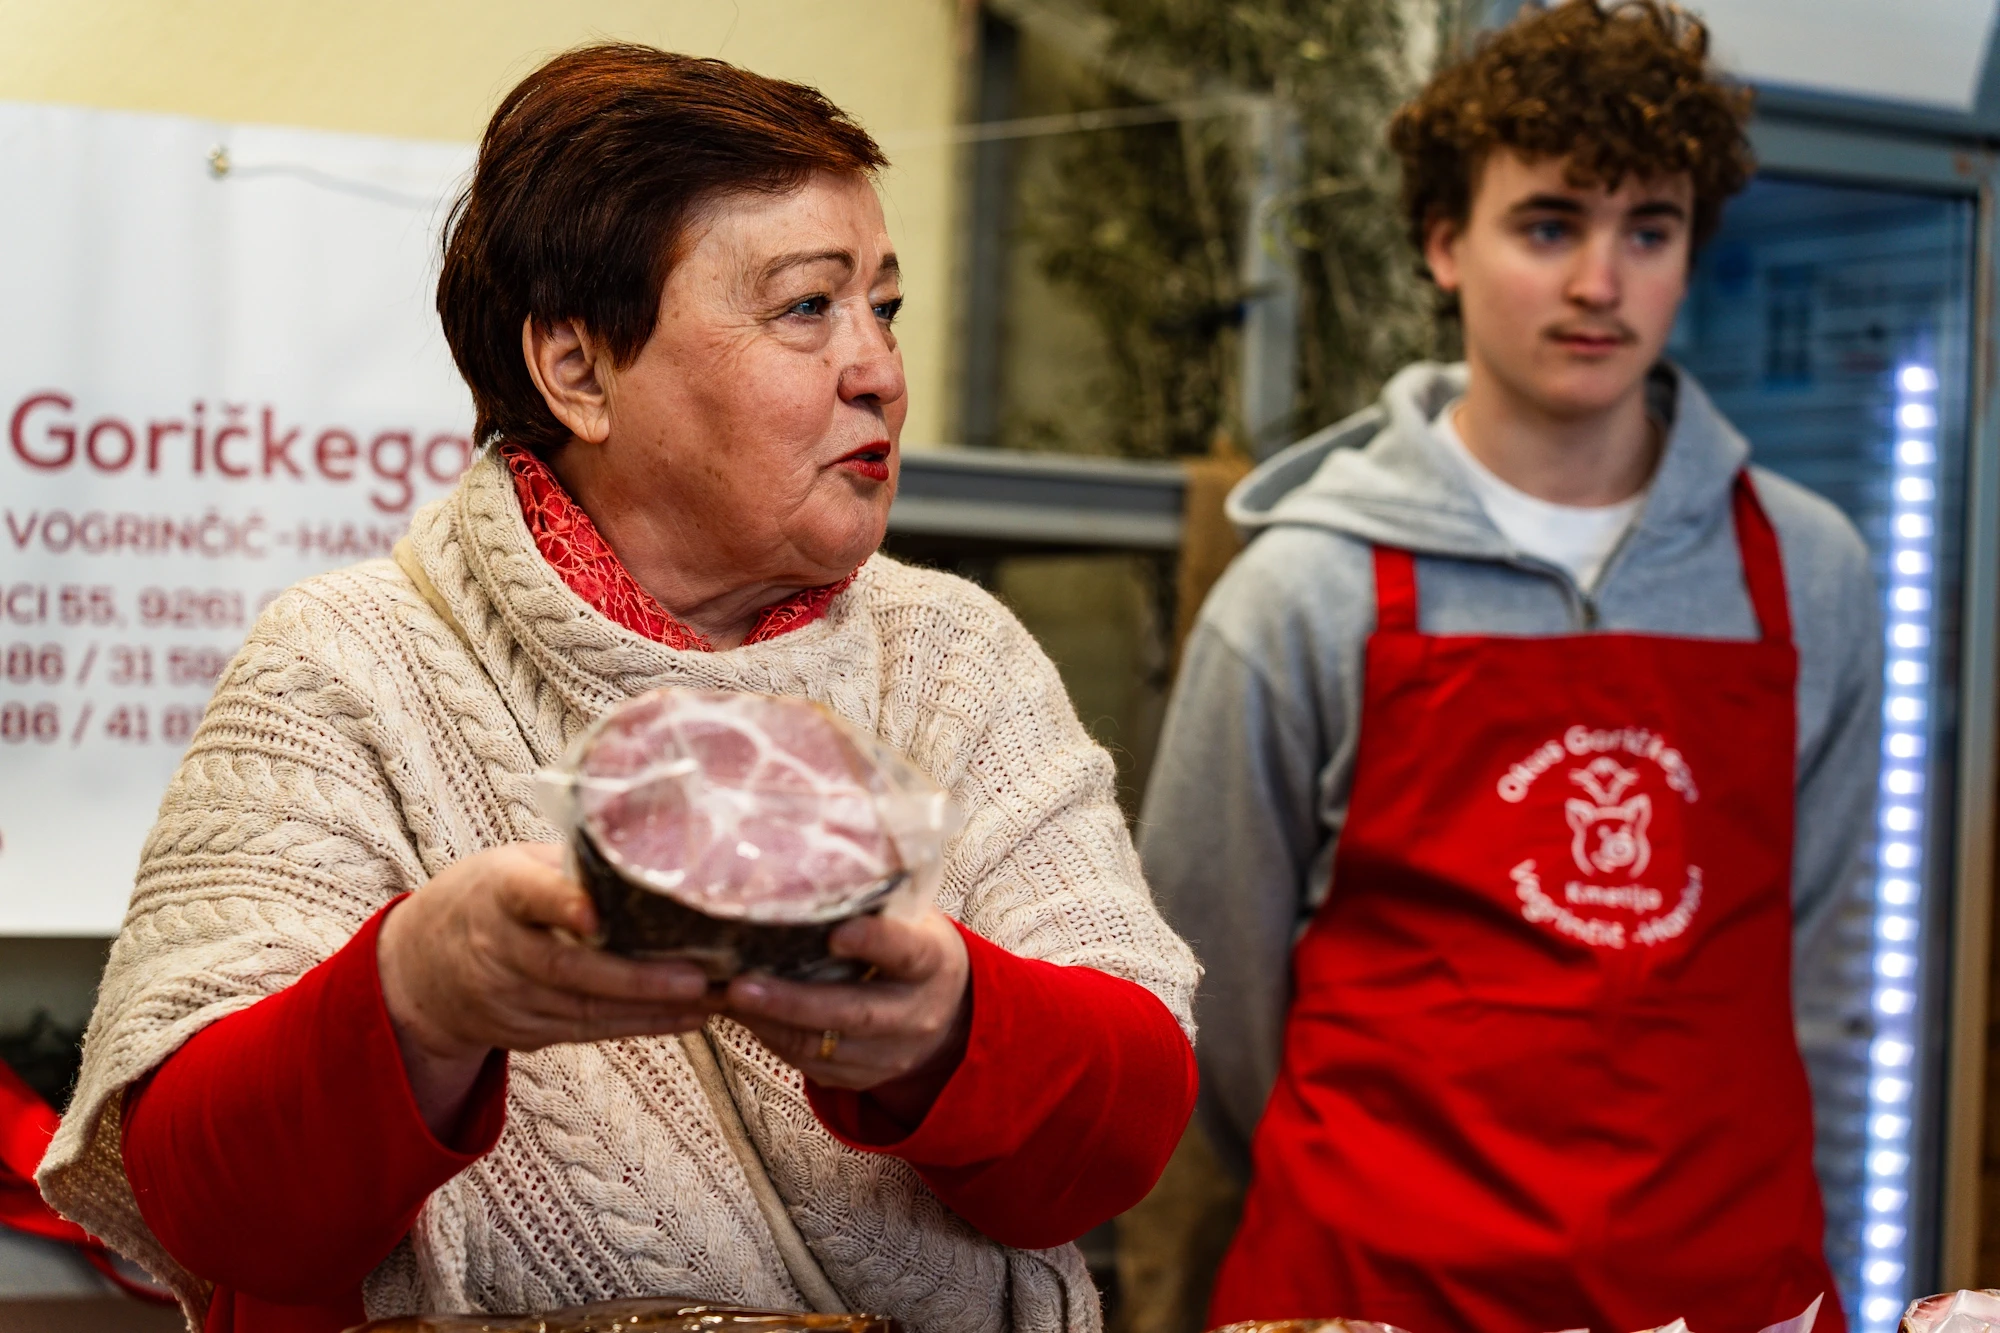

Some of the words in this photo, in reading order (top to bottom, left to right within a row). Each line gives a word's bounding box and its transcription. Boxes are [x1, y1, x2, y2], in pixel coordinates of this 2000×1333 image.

[9, 389, 472, 515] Goričkega
[0, 582, 47, 625] CI
[138, 586, 246, 630] 9261
[106, 644, 154, 688] 31
[104, 704, 149, 748] 41
